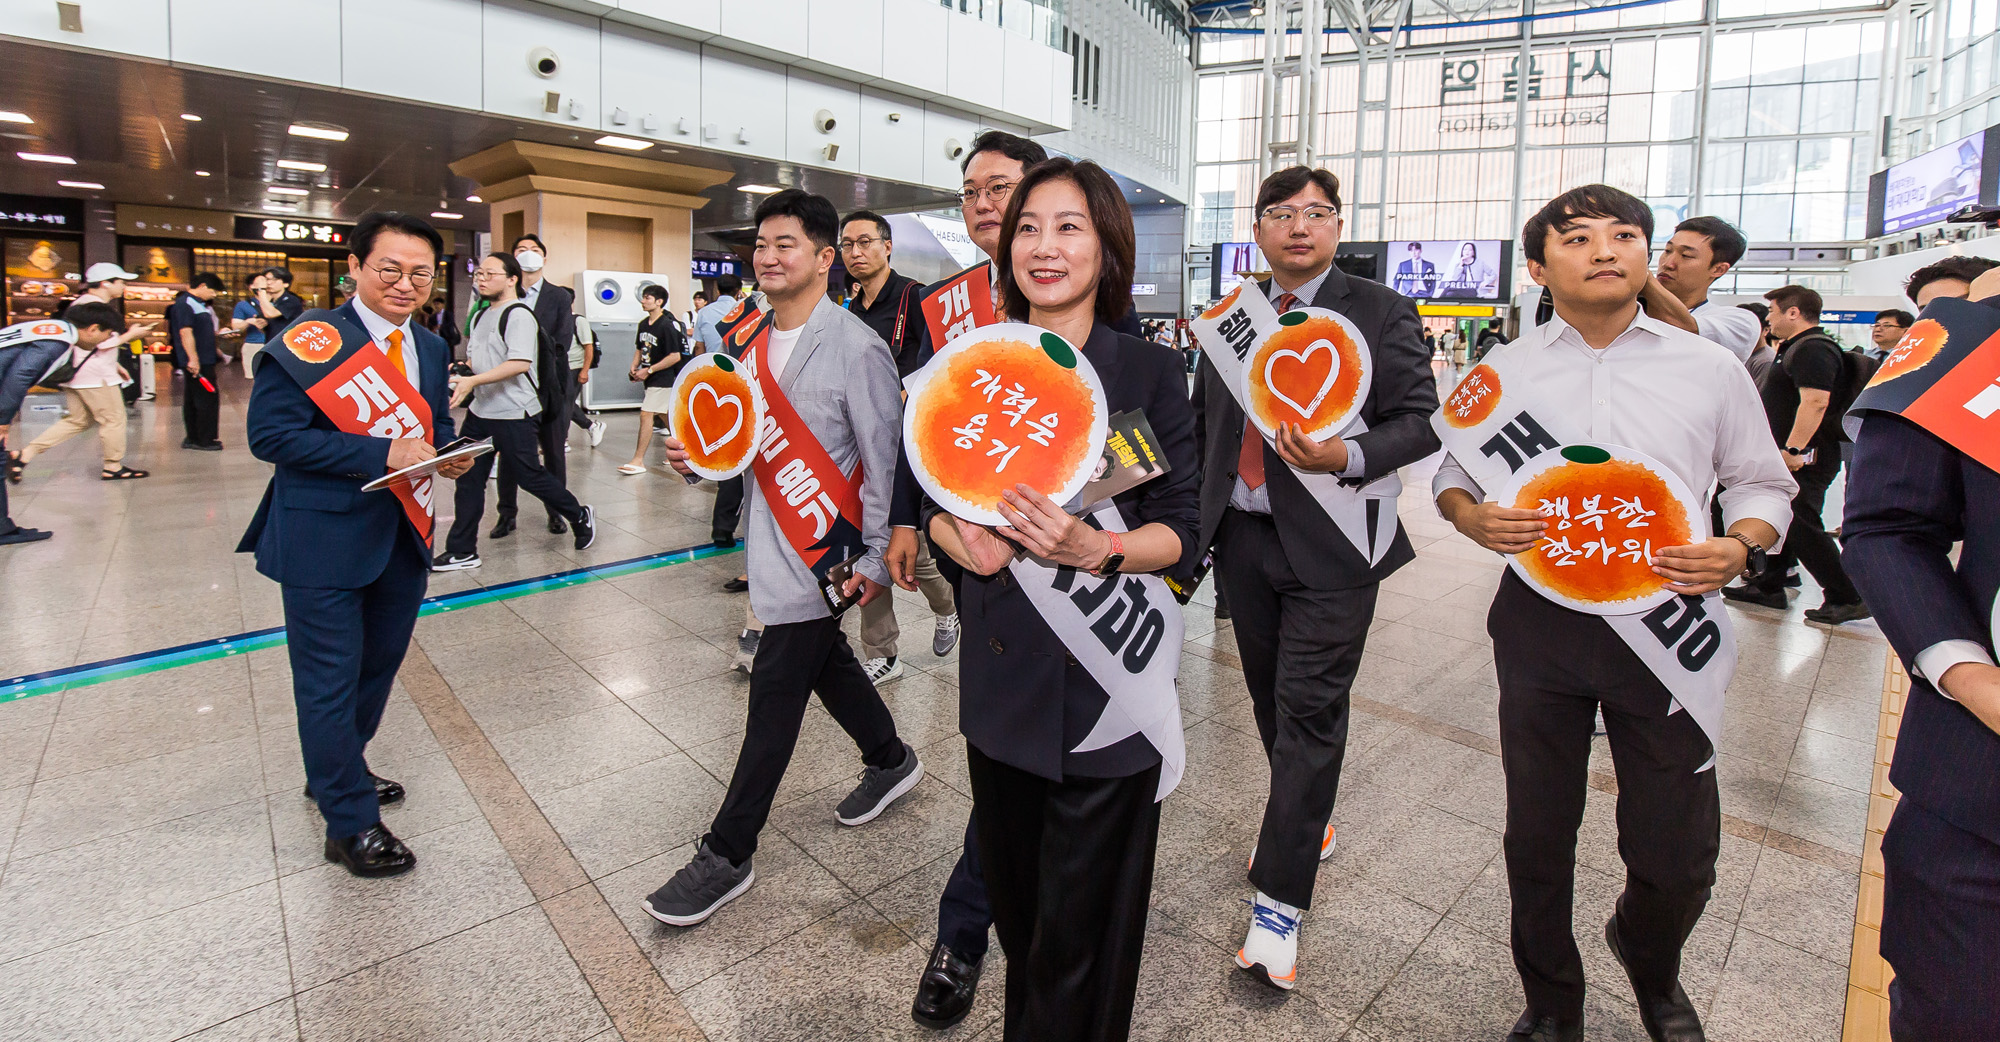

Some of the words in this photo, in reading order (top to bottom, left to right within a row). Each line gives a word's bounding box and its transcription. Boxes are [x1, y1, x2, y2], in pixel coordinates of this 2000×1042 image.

[936, 230, 971, 245] HAESUNG
[1396, 272, 1442, 281] PARKLAND
[1444, 281, 1477, 289] PRELIN
[895, 313, 904, 340] Canon
[1449, 373, 1482, 407] 행복한
[970, 368, 1059, 447] 개혁은
[952, 413, 1021, 474] 용기
[775, 458, 840, 541] 용기
[1537, 494, 1657, 532] 행복한
[1540, 536, 1656, 567] 한가위
